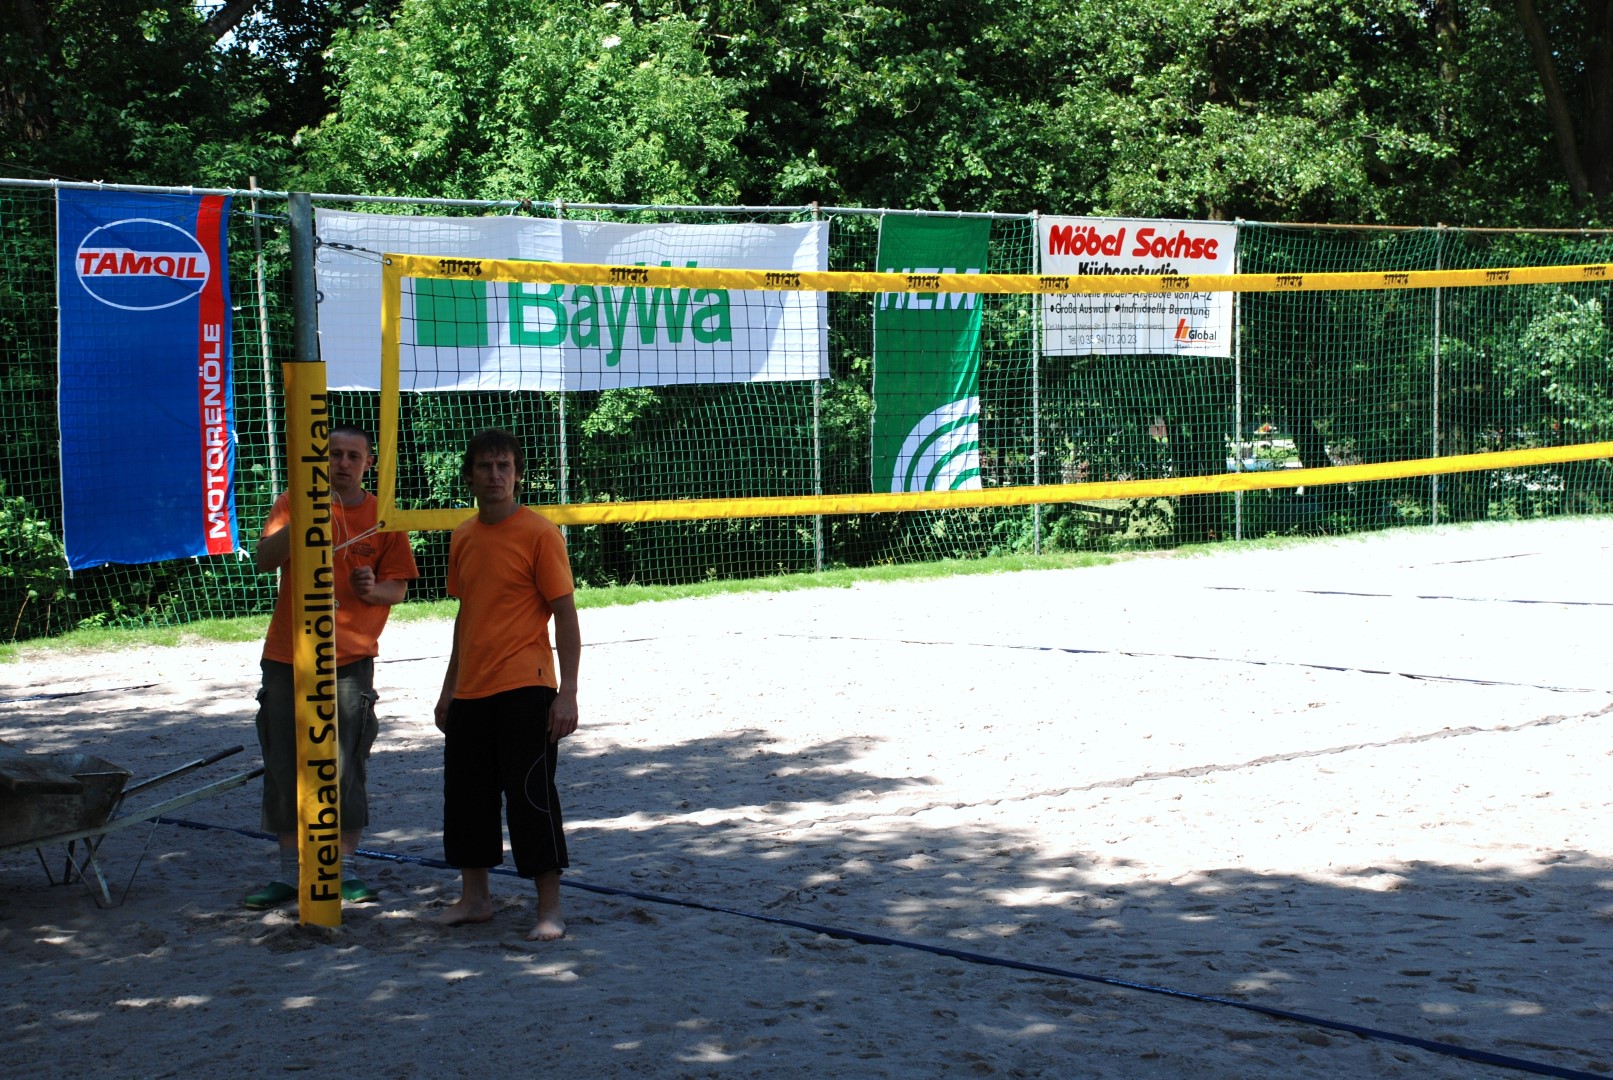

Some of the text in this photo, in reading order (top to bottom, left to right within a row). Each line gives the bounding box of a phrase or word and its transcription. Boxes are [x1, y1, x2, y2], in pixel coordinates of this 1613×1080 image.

[1049, 224, 1218, 260] Möbel Sachse
[78, 252, 206, 279] TAMOIL
[438, 259, 482, 277] HUCK
[609, 267, 648, 285] HUCK
[764, 272, 801, 288] HUCK
[907, 275, 941, 290] HUCK
[1038, 276, 1069, 290] HUCK
[1161, 276, 1189, 290] HUCK
[1275, 276, 1303, 289] HUCK
[508, 258, 732, 367] BayWa
[1056, 302, 1110, 314] Große Auswahl
[1169, 303, 1210, 318] Beratung
[1188, 329, 1217, 341] Global
[198, 323, 227, 540] MOTORENÖLE
[301, 393, 341, 903] Freibad Schmölln-Putzkau
